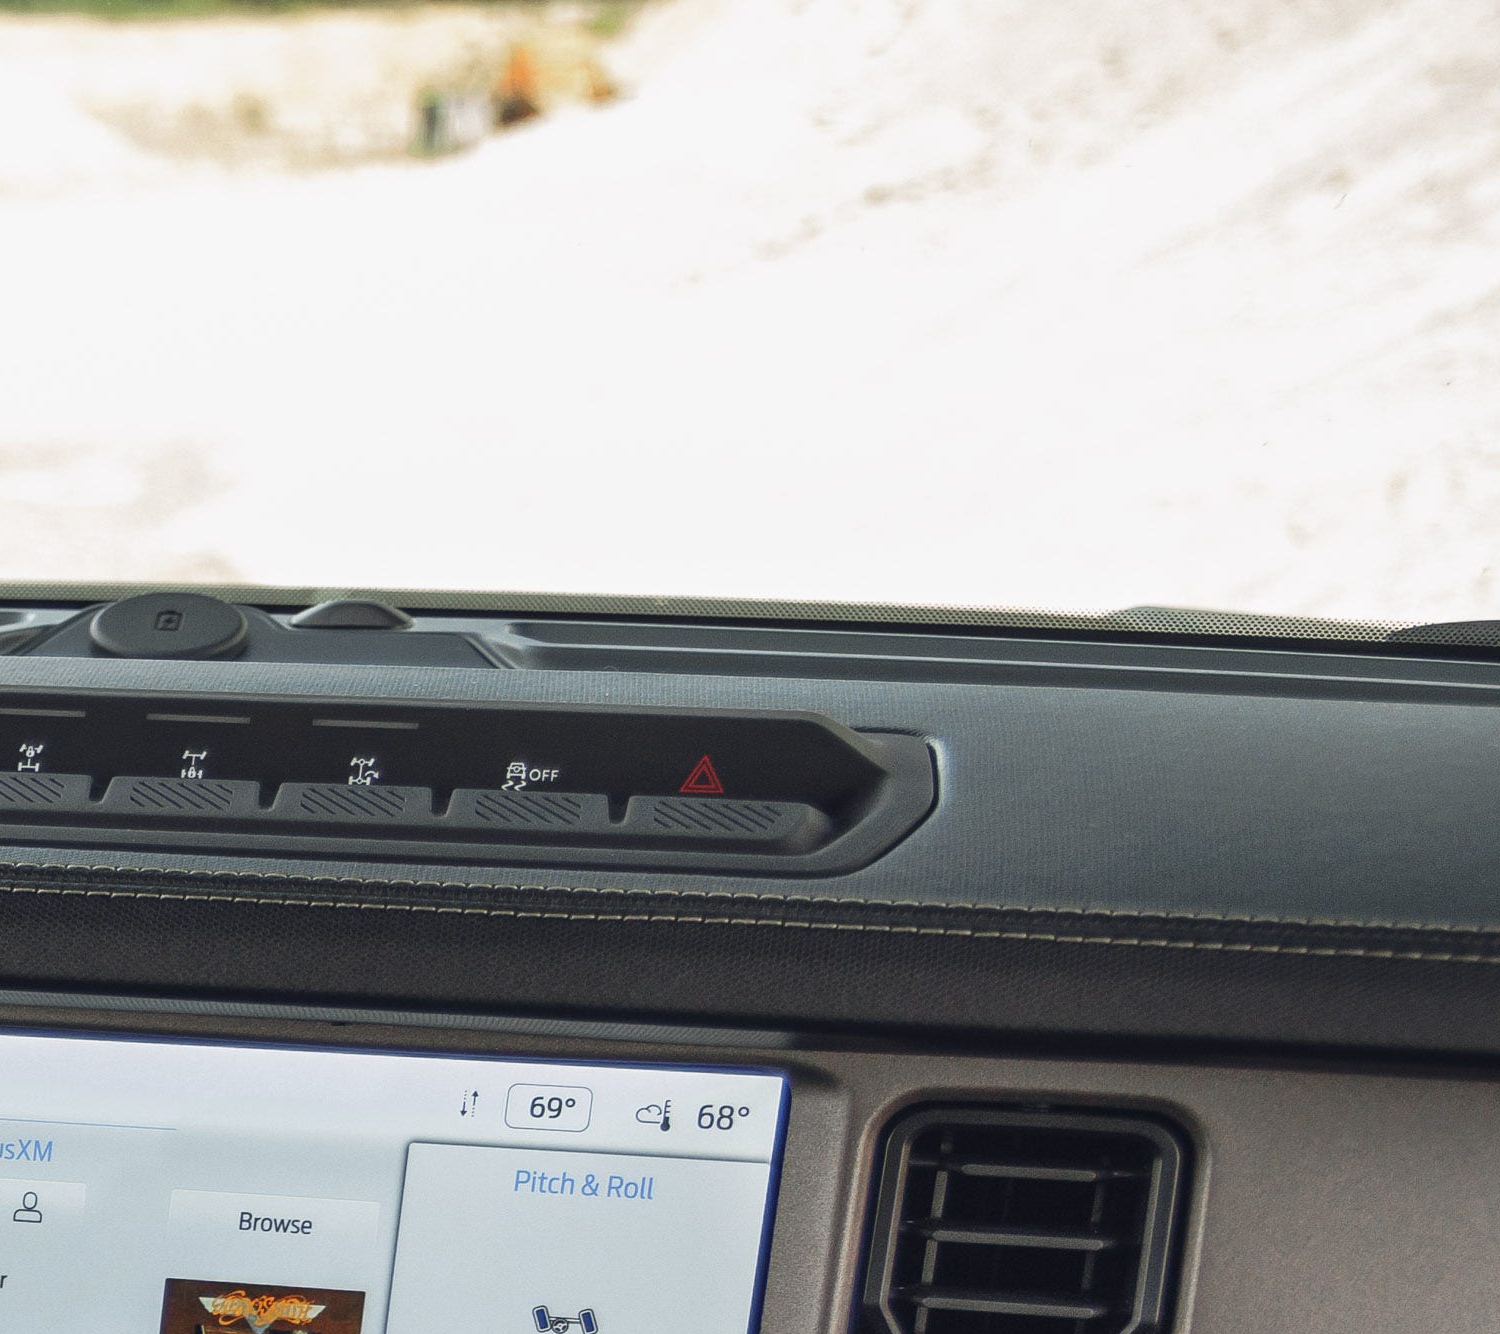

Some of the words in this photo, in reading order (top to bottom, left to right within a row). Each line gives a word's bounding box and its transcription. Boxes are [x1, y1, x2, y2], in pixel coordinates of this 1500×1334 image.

[529, 768, 559, 782] OFF
[529, 1095, 577, 1120] 69°
[697, 1104, 751, 1131] 68°
[514, 1169, 574, 1197] Pitch
[581, 1174, 601, 1198] &
[606, 1175, 654, 1201] Roll
[238, 1211, 313, 1236] Browse
